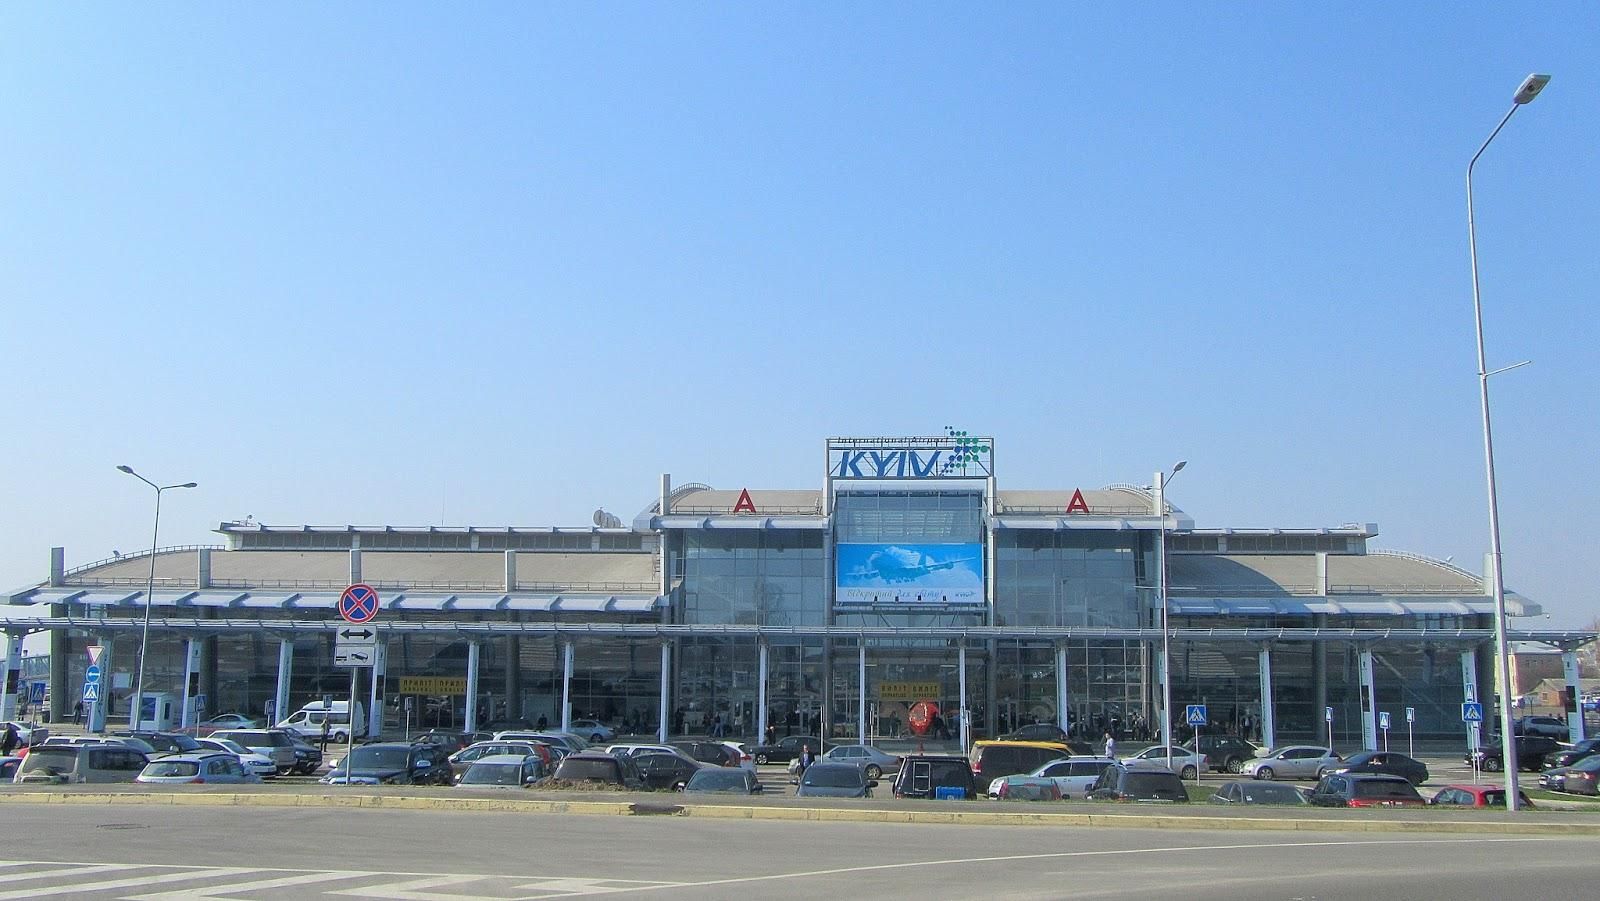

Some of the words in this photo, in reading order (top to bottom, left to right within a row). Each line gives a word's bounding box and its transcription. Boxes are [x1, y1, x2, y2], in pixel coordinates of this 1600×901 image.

[837, 436, 907, 444] International
[910, 436, 949, 445] Airport
[839, 451, 942, 477] KYIV
[733, 487, 757, 513] A
[1065, 487, 1090, 513] A
